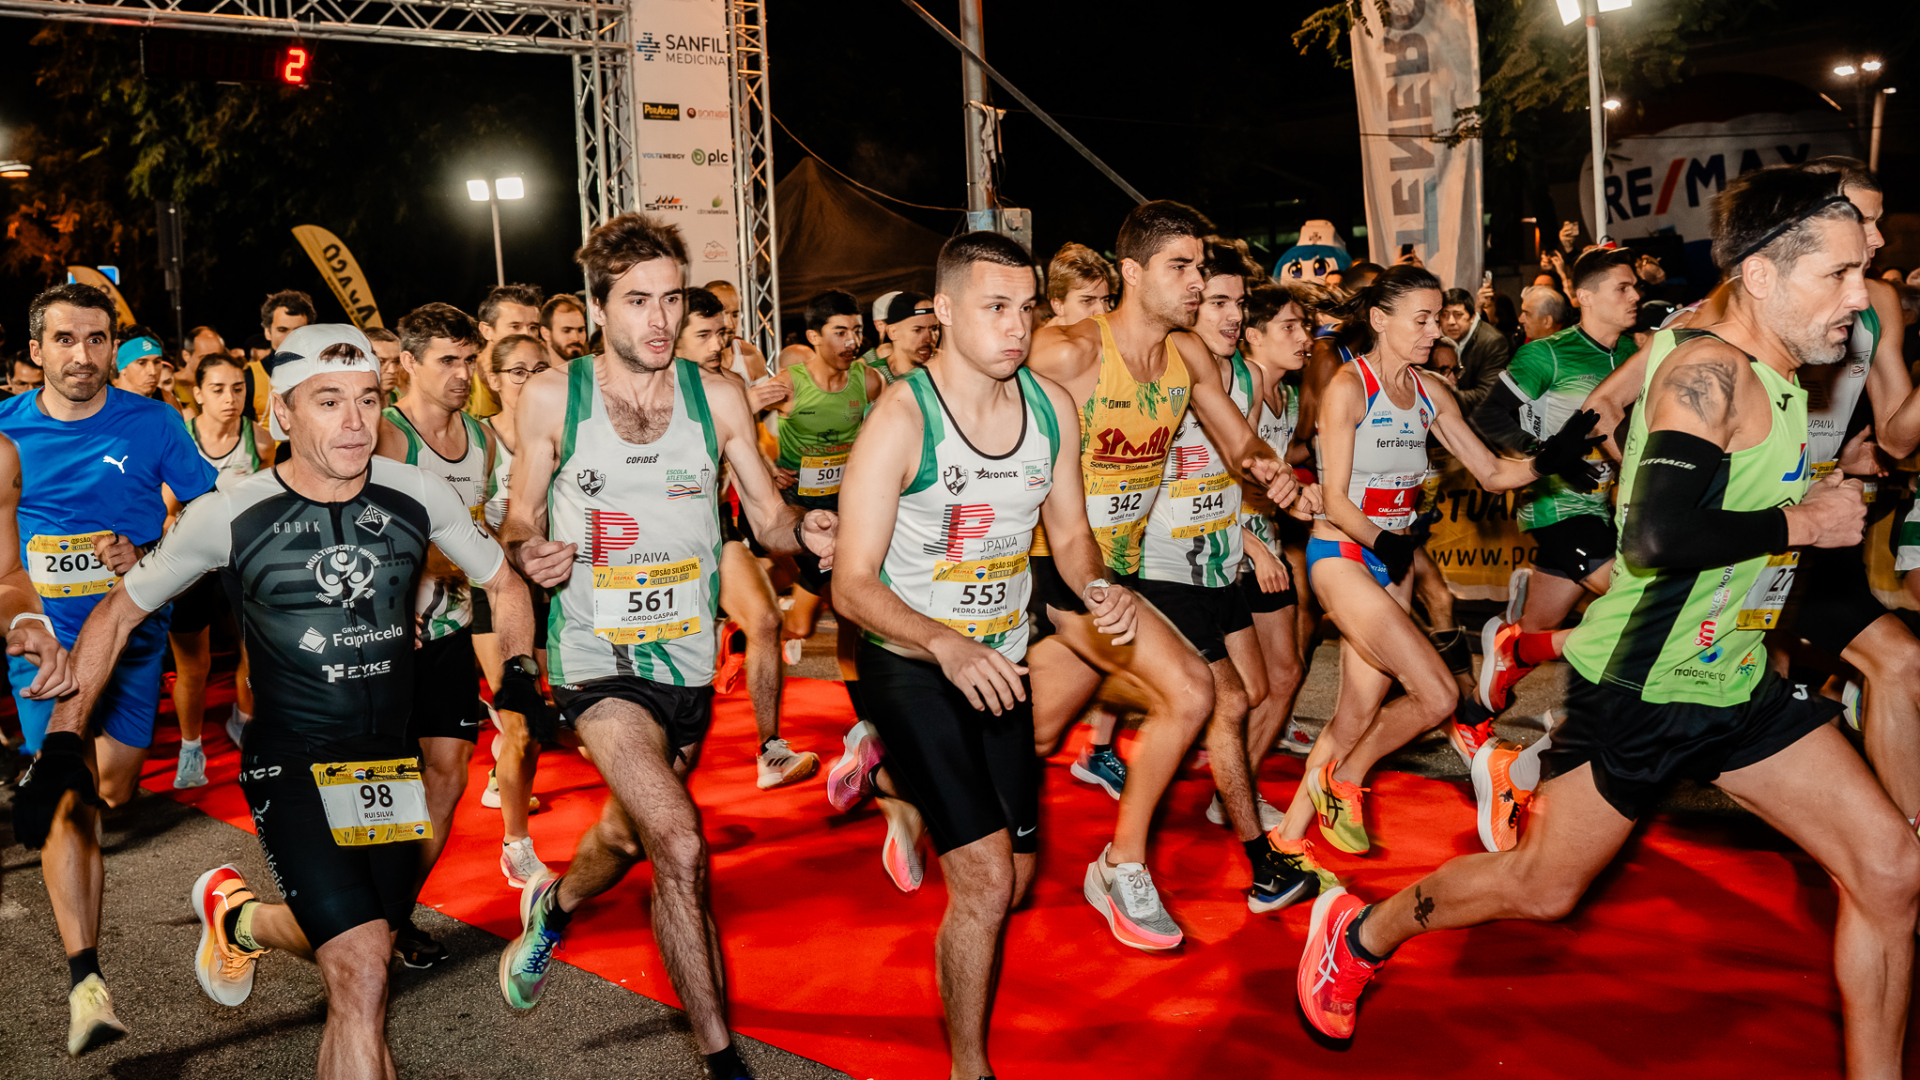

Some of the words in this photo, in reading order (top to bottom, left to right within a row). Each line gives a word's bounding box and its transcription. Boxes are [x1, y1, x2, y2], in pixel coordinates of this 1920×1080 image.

[665, 33, 726, 54] SANFIL
[285, 48, 306, 82] 2
[665, 52, 726, 66] MEDICINA
[708, 149, 729, 166] plc
[626, 455, 658, 464] COFIDES
[817, 467, 841, 481] 501
[1108, 493, 1142, 515] 342
[1192, 493, 1223, 515] 544
[1394, 490, 1405, 506] 4
[273, 521, 321, 533] GOBIK
[980, 537, 1018, 553] JPAIVA
[305, 544, 357, 570] MULTISPORT
[626, 552, 671, 564] JPAIVA
[660, 568, 671, 577] SÃO
[671, 562, 699, 574] SILVESTRE
[628, 587, 674, 613] 561
[960, 582, 1007, 606] 553
[653, 611, 679, 621] GASPAR
[332, 624, 403, 648] Fapricela
[342, 624, 367, 634] GRUPO
[360, 784, 393, 809] 98
